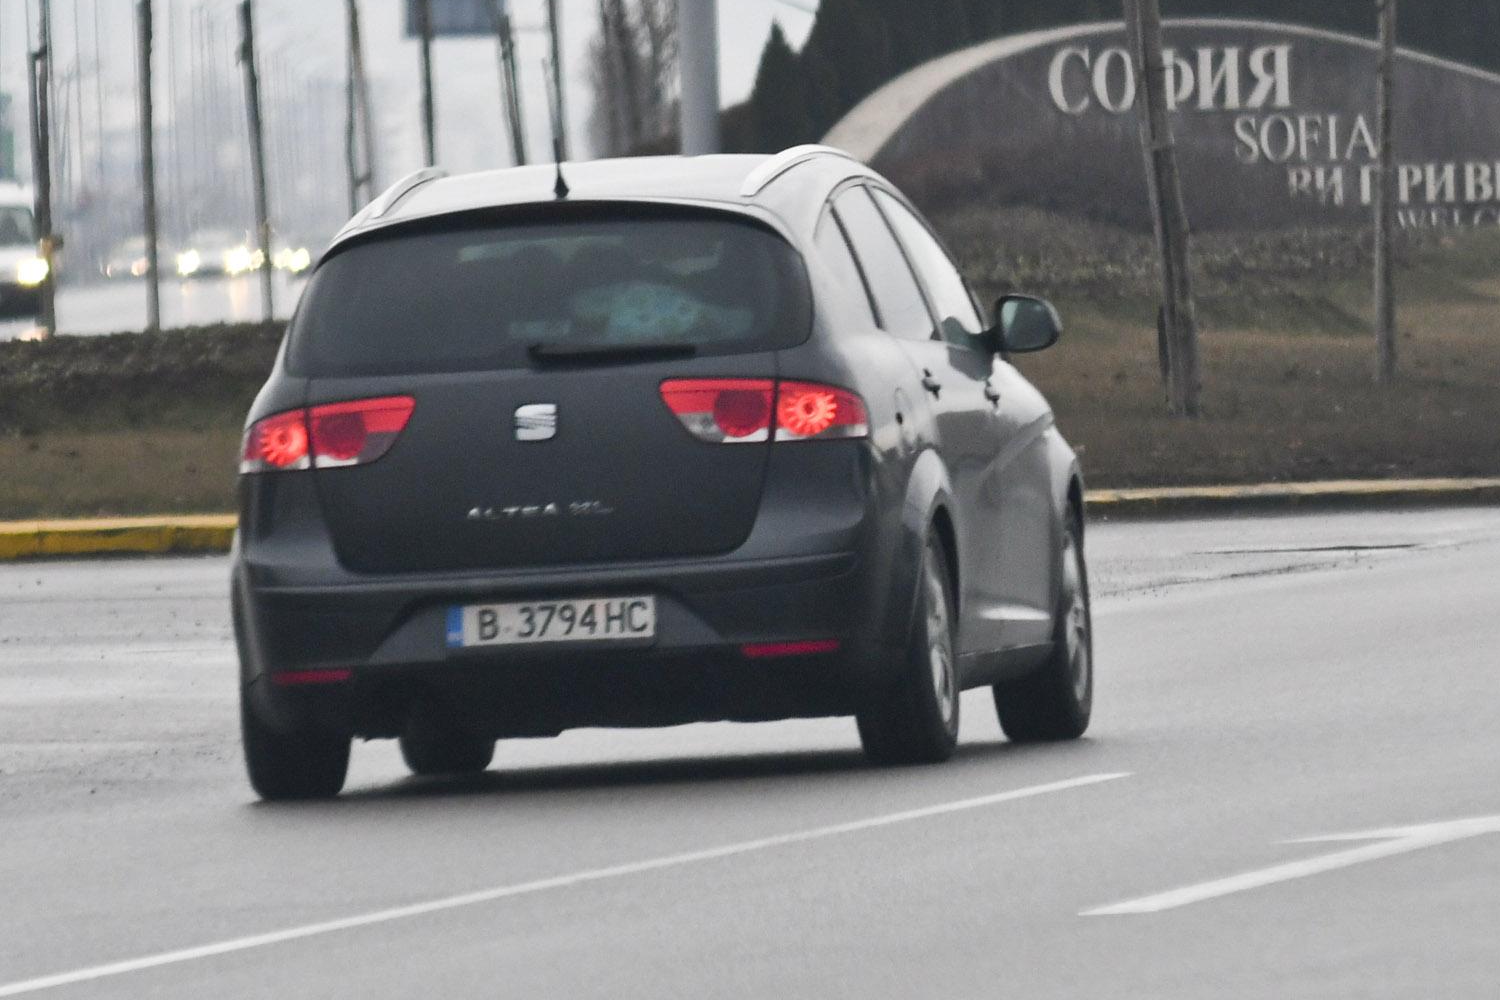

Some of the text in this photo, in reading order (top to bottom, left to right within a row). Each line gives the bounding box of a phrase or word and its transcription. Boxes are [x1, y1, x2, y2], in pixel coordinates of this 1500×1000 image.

[1048, 45, 1293, 114] СОФИЯ
[1234, 113, 1378, 164] SOFIA
[478, 600, 648, 641] B 3794 HC
